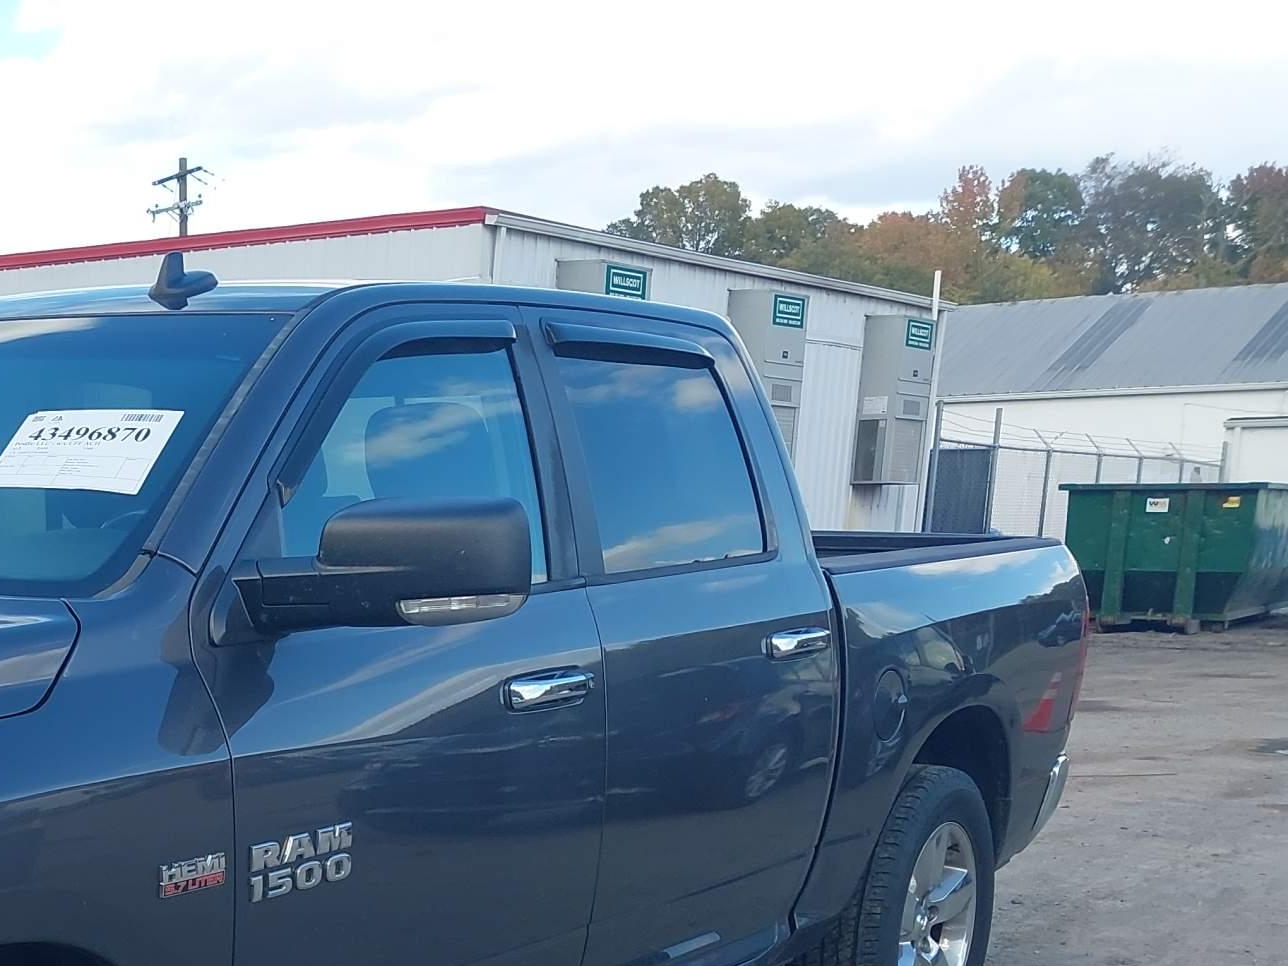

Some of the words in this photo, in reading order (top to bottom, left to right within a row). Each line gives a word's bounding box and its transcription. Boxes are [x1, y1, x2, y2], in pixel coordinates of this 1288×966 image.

[613, 275, 640, 289] WILLSCOT
[28, 425, 152, 444] 43496870
[250, 822, 353, 872] RAM
[159, 852, 227, 886] HEMI
[165, 880, 187, 896] 5.7
[188, 871, 225, 890] LITER
[250, 853, 353, 904] 1500
